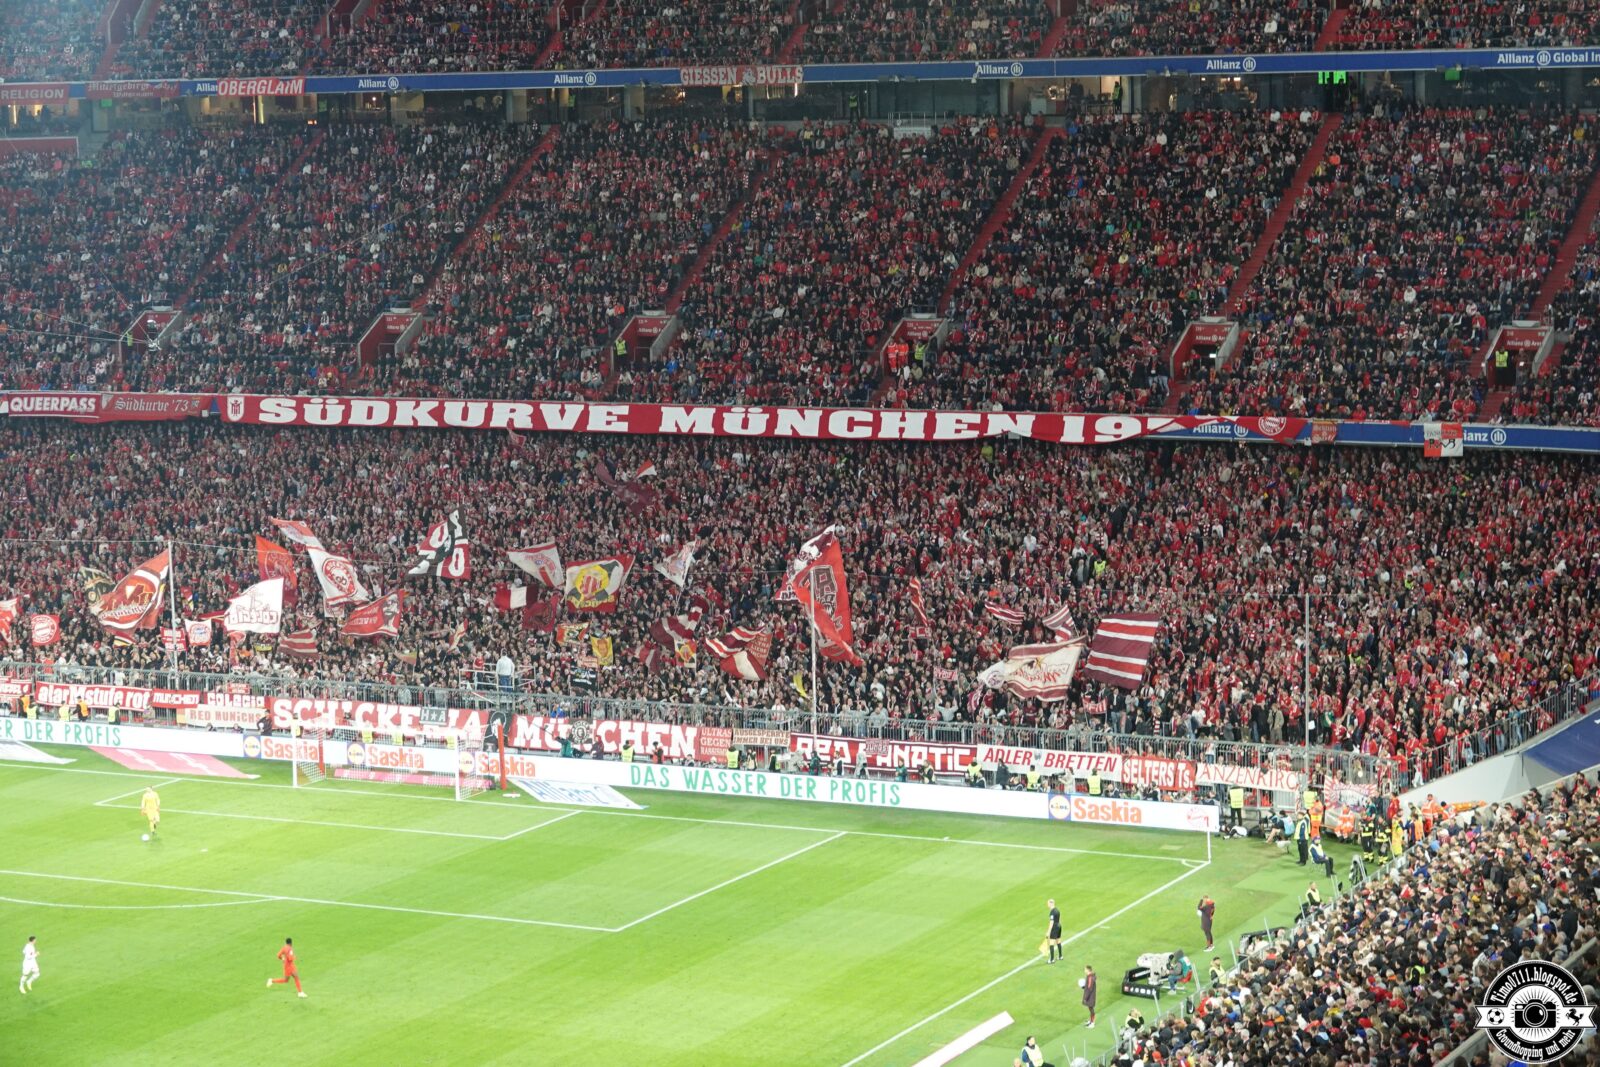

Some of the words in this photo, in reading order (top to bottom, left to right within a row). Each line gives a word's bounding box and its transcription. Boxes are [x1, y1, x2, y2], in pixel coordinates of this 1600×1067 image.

[1207, 59, 1241, 69] Allianz
[1497, 53, 1534, 63] Allianz
[1553, 52, 1588, 63] Global
[681, 67, 737, 85] GIESSEN
[757, 64, 803, 83] BULLS
[976, 64, 1008, 75] Allianz
[358, 79, 386, 88] Allianz
[554, 74, 583, 84] Allianz
[1, 88, 64, 100] RELIGION
[10, 397, 96, 412] QUEERPASS
[115, 398, 169, 411] Südkurve
[259, 397, 629, 432] SÜDKURVE
[659, 405, 1036, 439] MÜNCHEN
[1193, 424, 1231, 434] Allianz
[190, 710, 211, 721] RED
[24, 720, 54, 742] DER
[64, 723, 121, 747] PROFIS
[701, 728, 732, 737] ULTRAS
[701, 737, 730, 747] GEGEN
[263, 737, 318, 761] Saskia
[368, 745, 425, 769] Saskia
[983, 747, 1033, 766] ADLER
[1045, 752, 1117, 773] BRETTEN
[1123, 755, 1176, 788] SELTERS
[631, 765, 670, 788] DAS
[683, 769, 767, 796] WASSER
[781, 775, 817, 800] DER
[830, 779, 900, 806] PROFIS
[1074, 797, 1142, 824] Saskia
